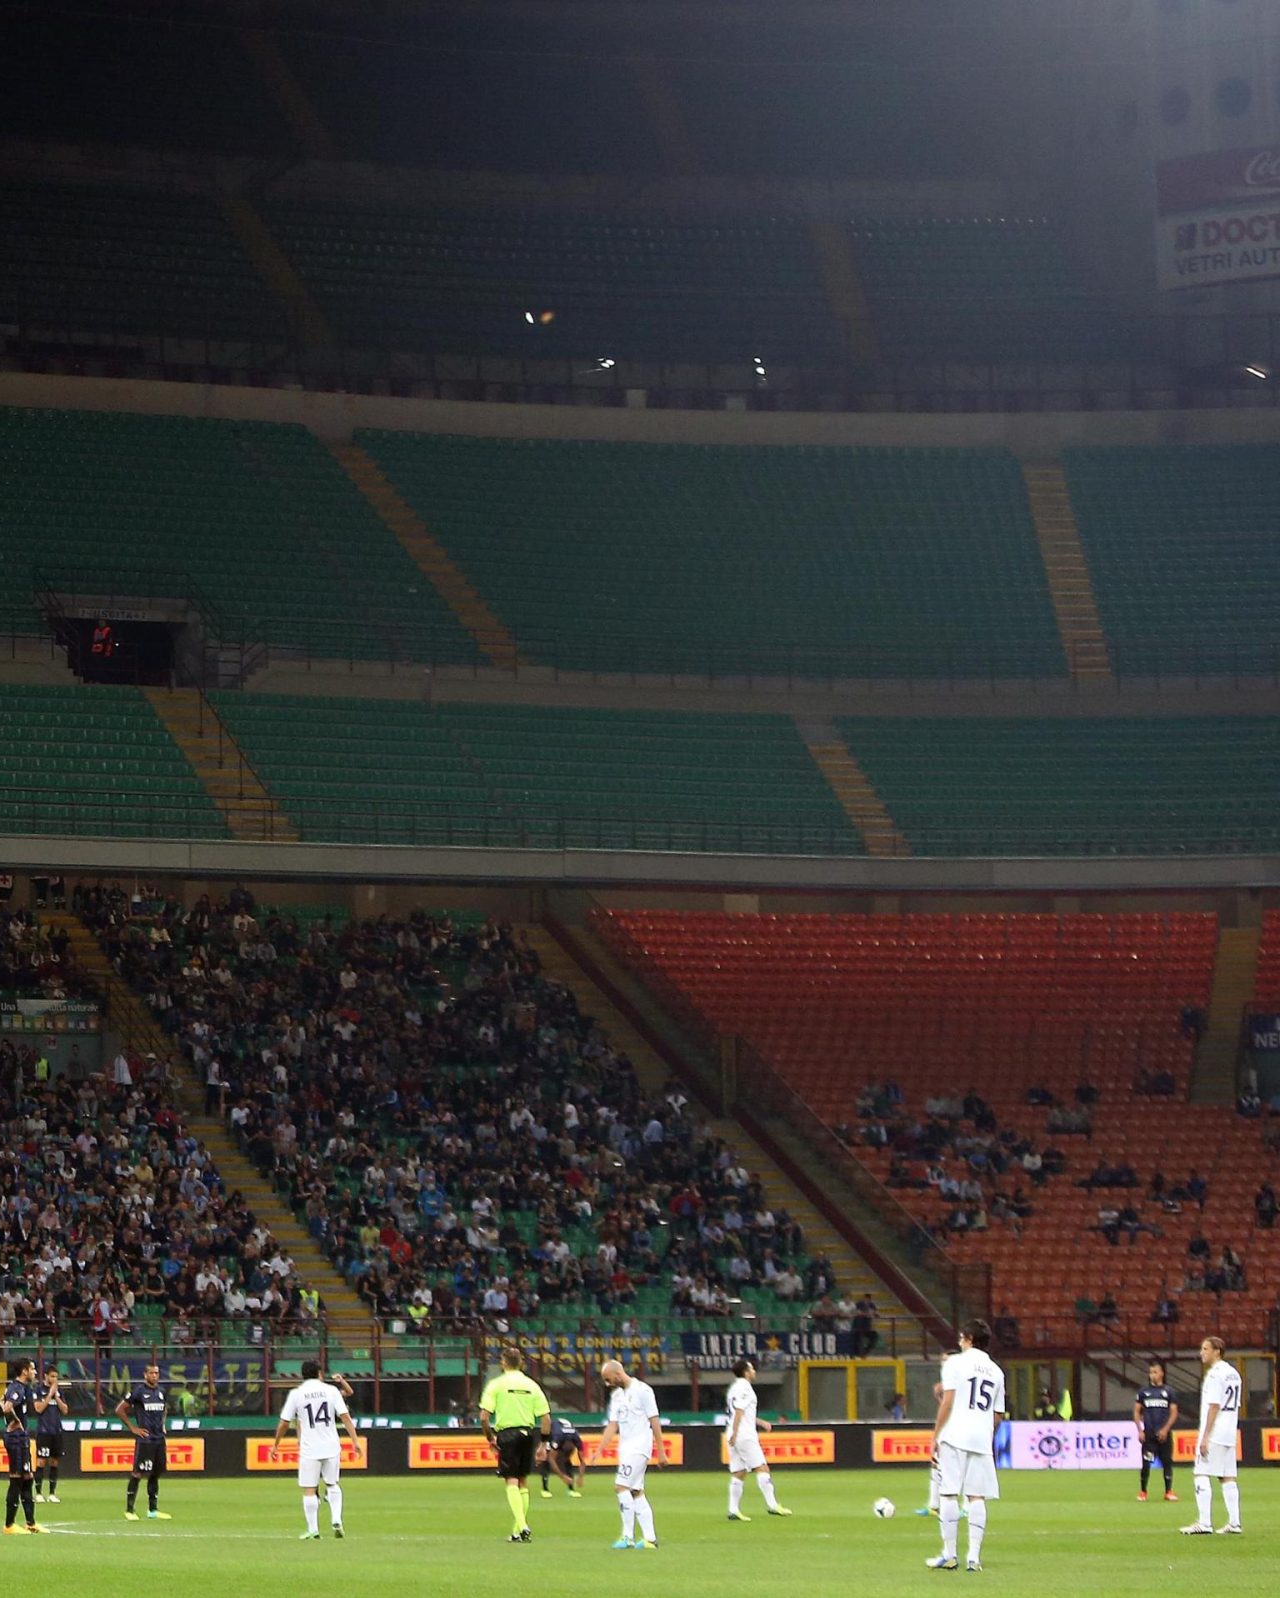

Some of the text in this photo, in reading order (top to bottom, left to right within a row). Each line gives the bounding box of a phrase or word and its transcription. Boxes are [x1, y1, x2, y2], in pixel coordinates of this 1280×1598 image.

[1175, 252, 1231, 276] VETRI
[700, 1333, 837, 1355] INTER CLUB
[108, 1362, 261, 1395] MSATE
[967, 1376, 995, 1412] 15
[1221, 1385, 1240, 1412] 21
[304, 1401, 331, 1429] 14
[1075, 1432, 1131, 1449] inter
[1075, 1450, 1129, 1461] campus
